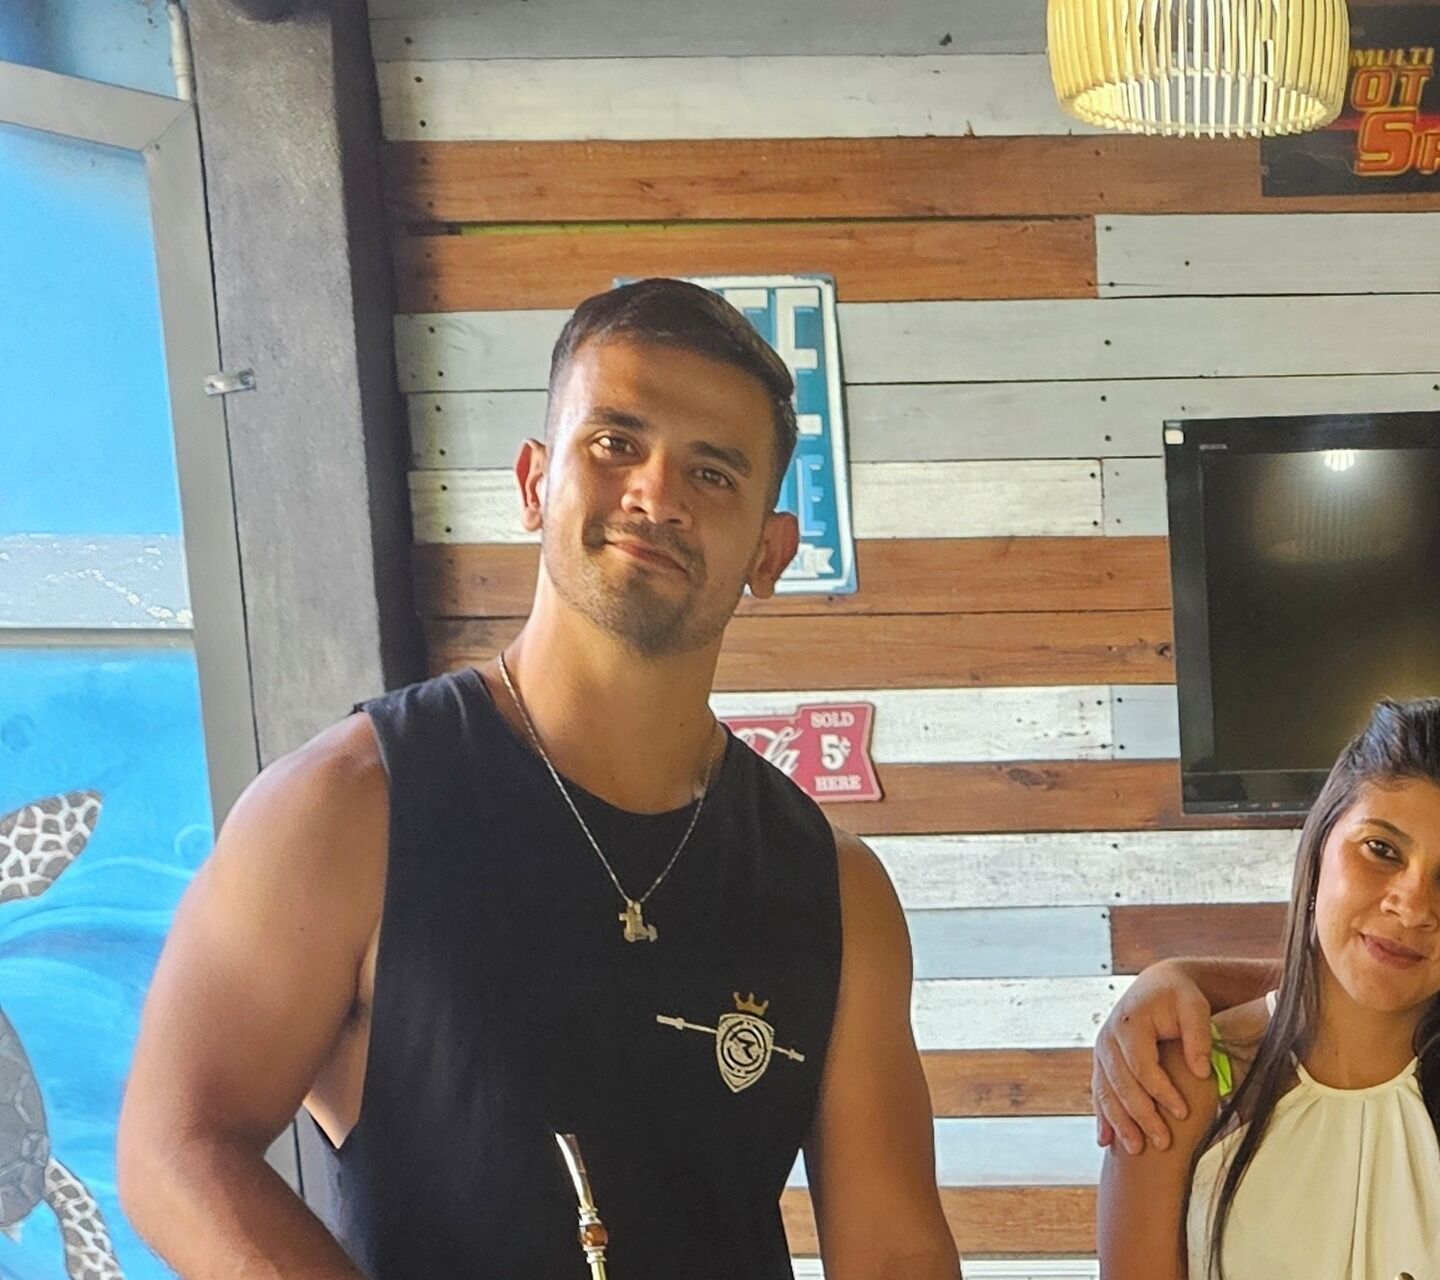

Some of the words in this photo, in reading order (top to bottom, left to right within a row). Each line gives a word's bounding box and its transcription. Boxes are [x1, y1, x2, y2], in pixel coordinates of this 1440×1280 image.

[1349, 47, 1435, 67] MULTI
[1350, 66, 1433, 108] OT
[810, 711, 855, 729] SOLD
[814, 774, 862, 792] HERE
